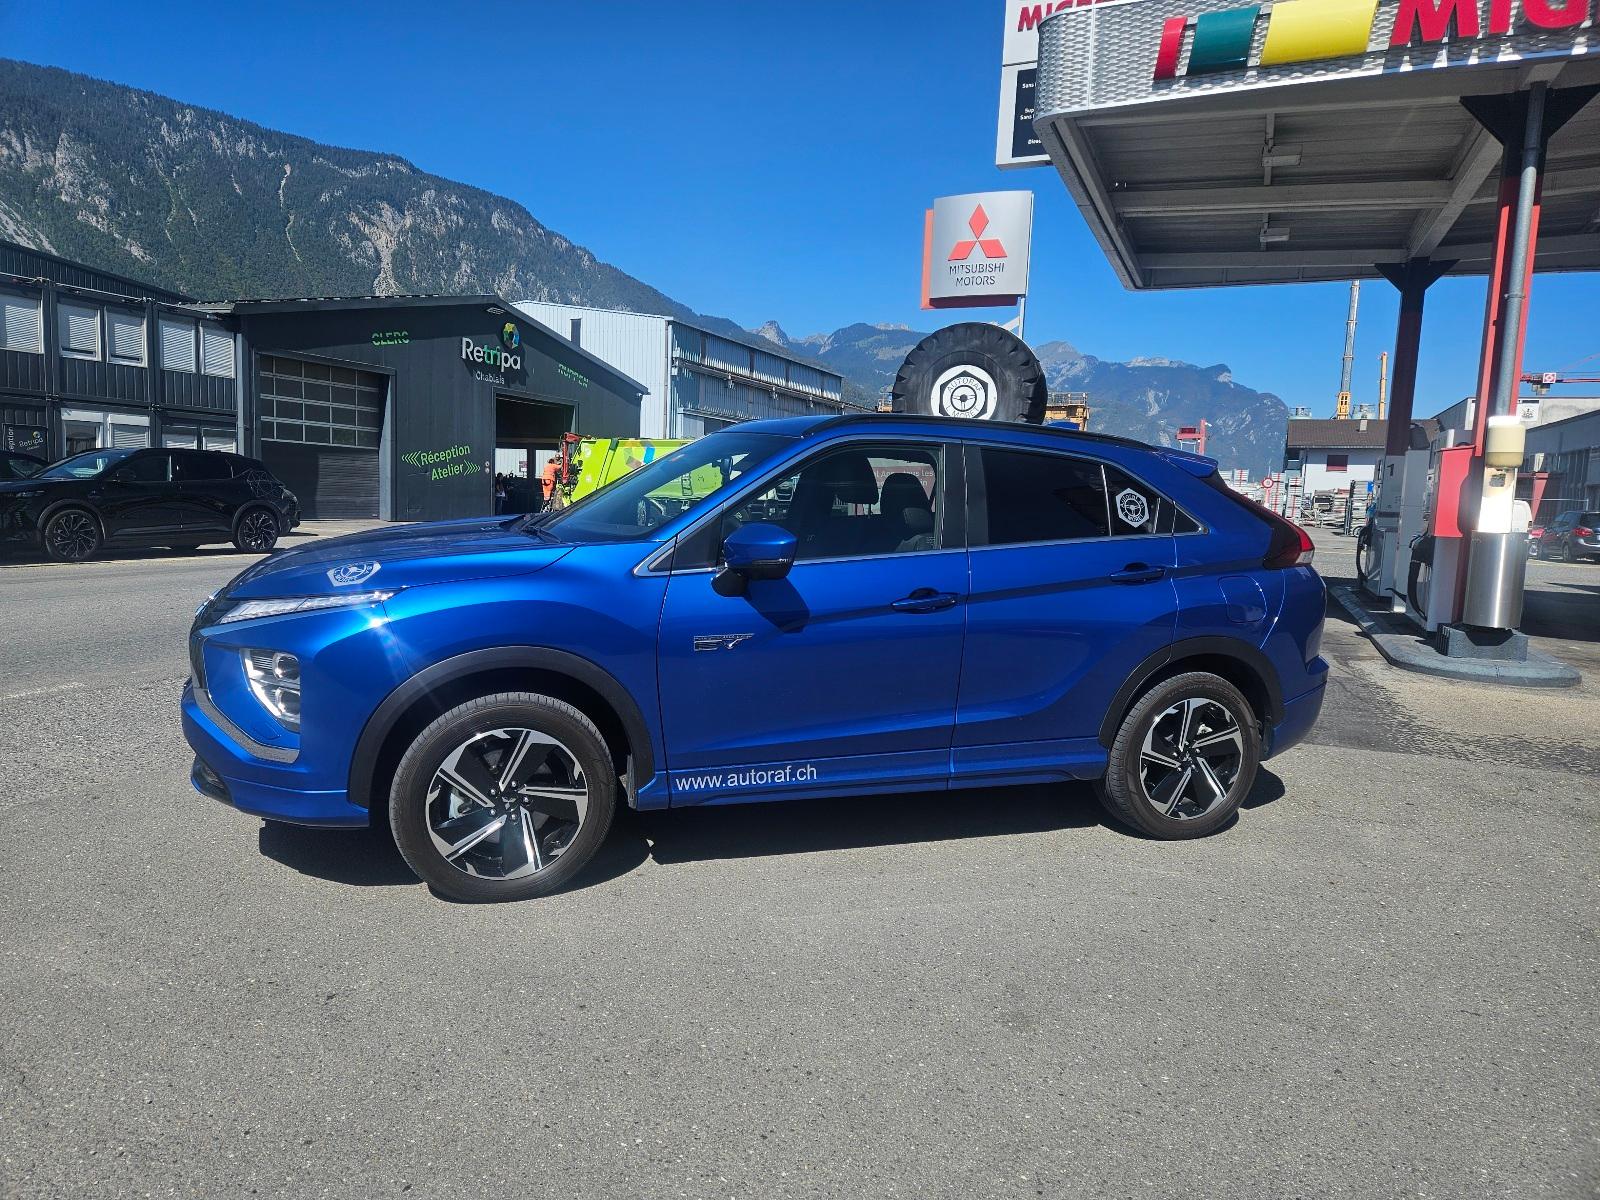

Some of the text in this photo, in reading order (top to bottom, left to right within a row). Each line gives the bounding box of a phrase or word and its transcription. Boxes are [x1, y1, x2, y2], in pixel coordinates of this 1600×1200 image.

[949, 263, 1005, 276] MITSUBISHI
[955, 275, 996, 287] MOTORS
[461, 336, 521, 373] Retripa
[475, 370, 505, 385] Chablais
[420, 444, 471, 466] Réception
[431, 463, 464, 481] Atelier
[675, 764, 818, 791] www.autoraf.ch
